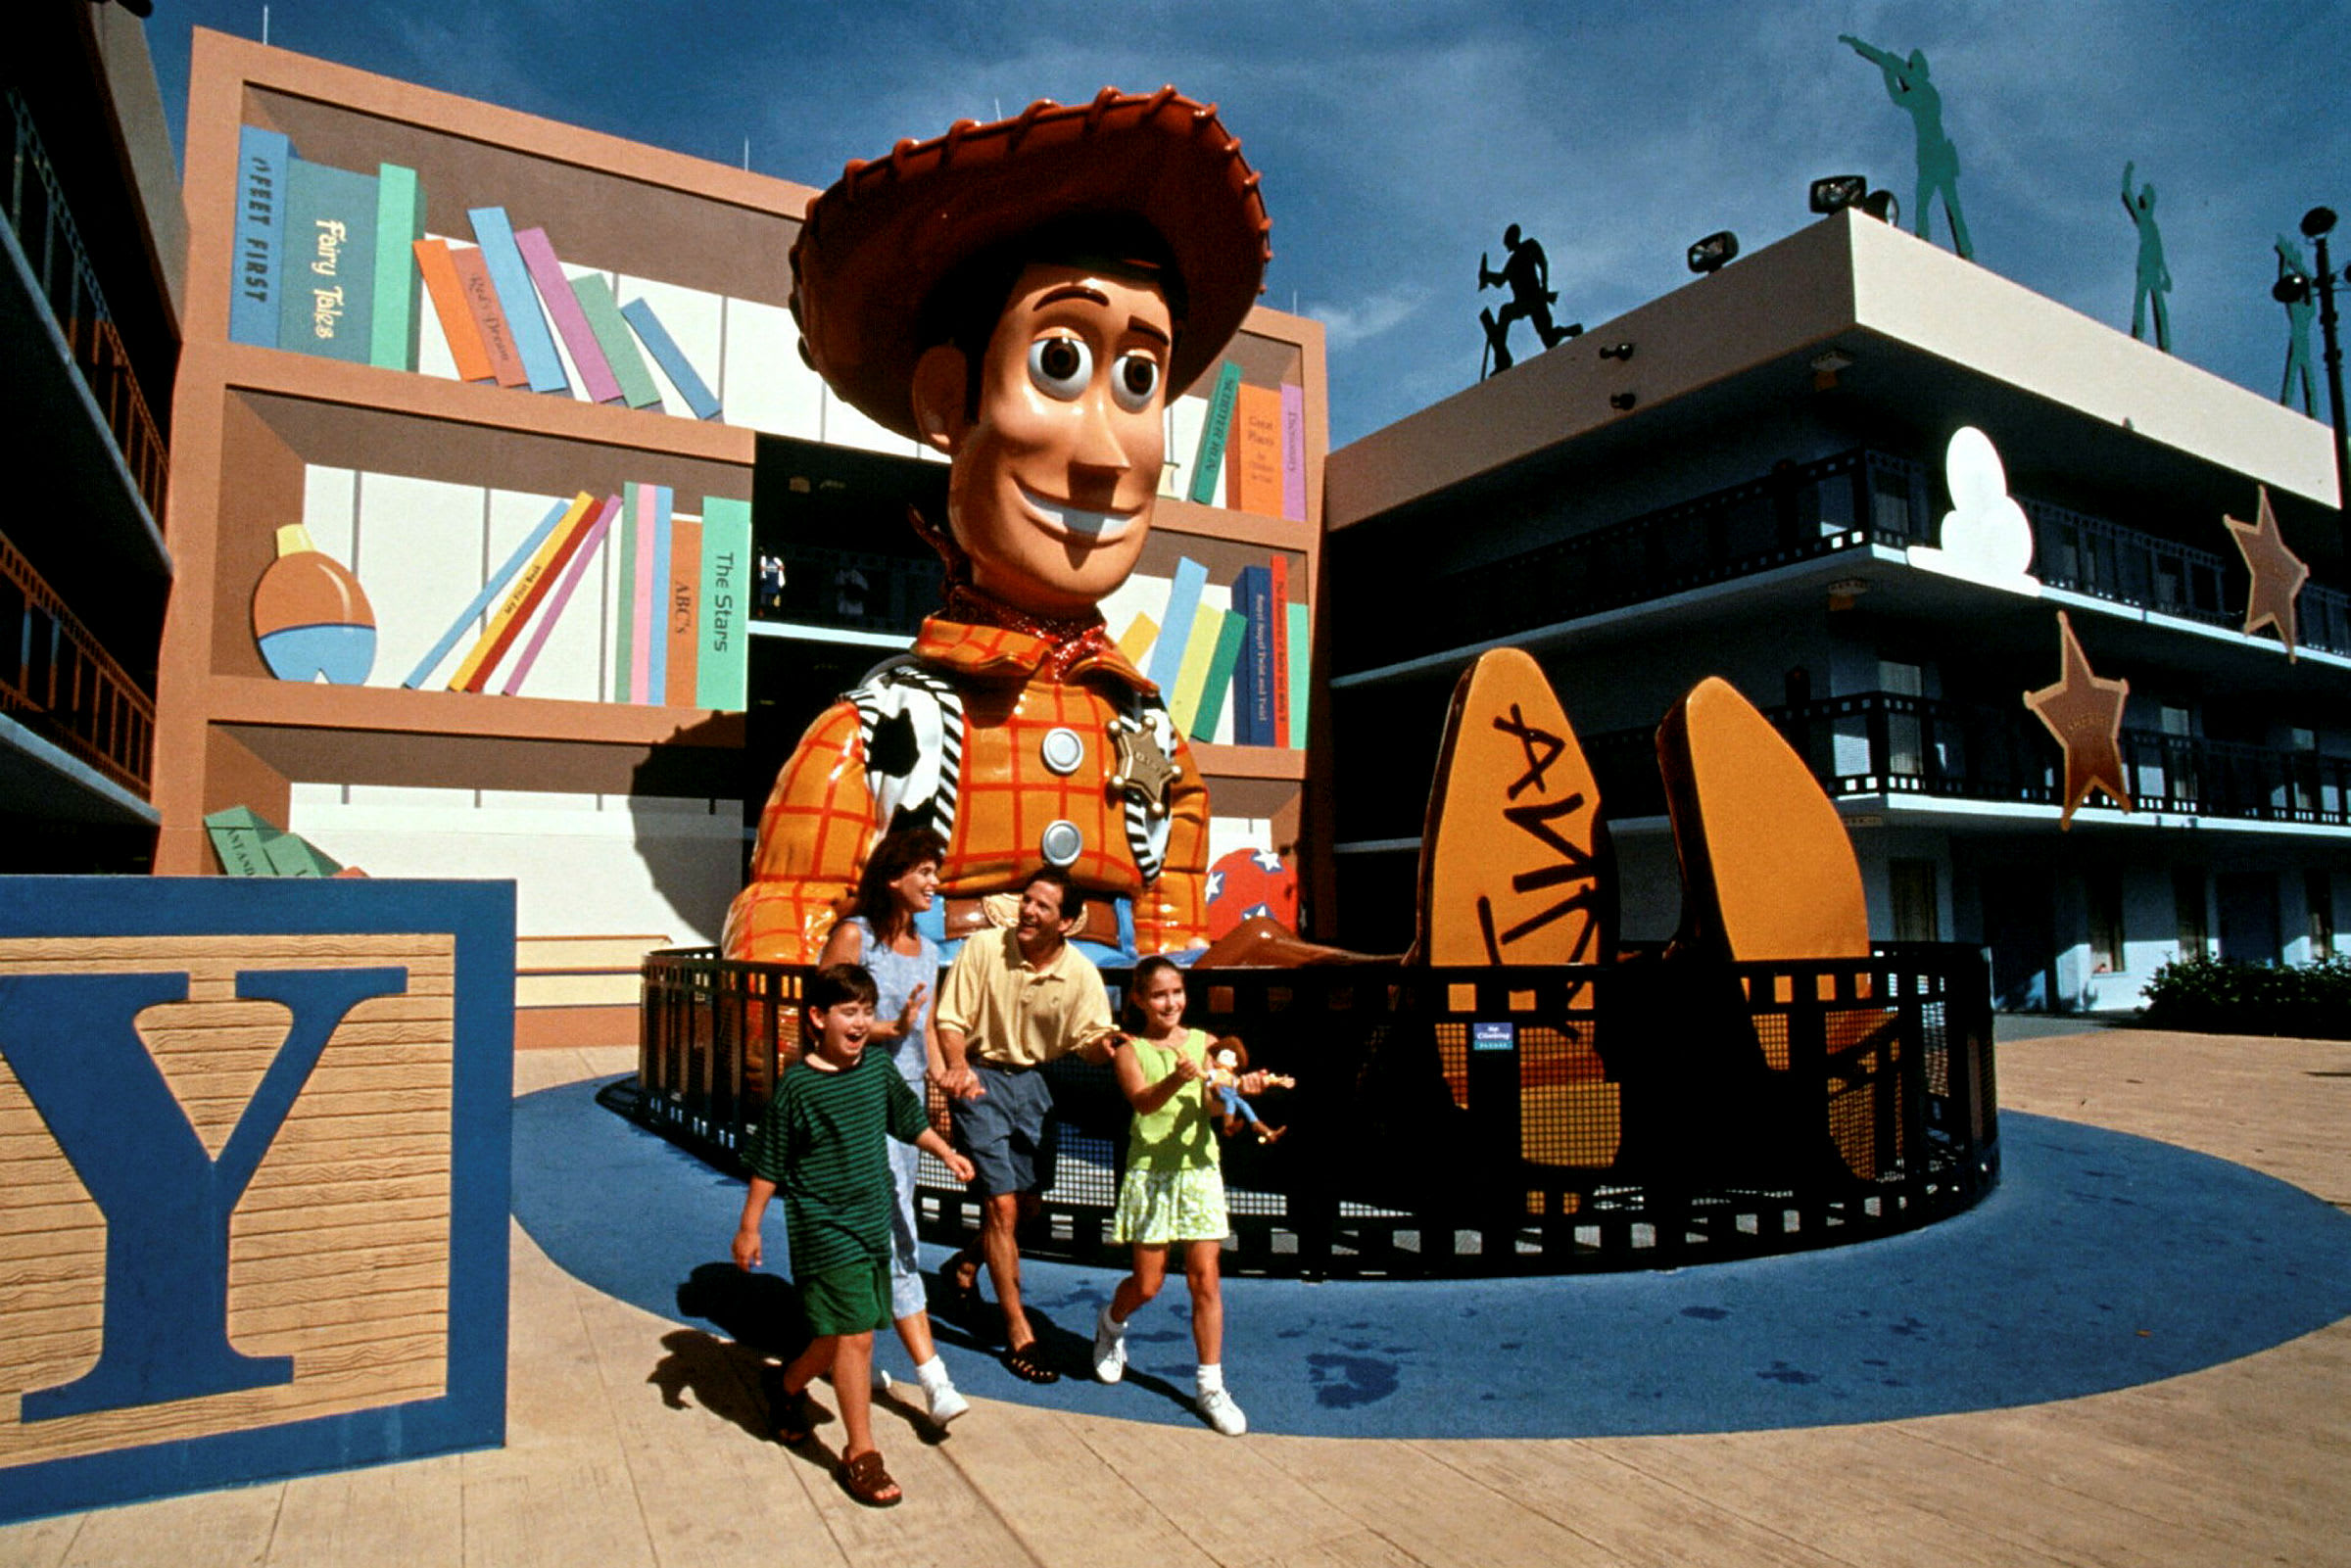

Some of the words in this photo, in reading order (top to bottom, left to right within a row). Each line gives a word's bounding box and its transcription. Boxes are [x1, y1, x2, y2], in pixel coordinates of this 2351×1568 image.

[248, 174, 272, 226] FEET
[244, 237, 268, 303] FIRST
[312, 220, 346, 276] Fairy
[314, 286, 343, 339] Tales
[715, 552, 734, 587] The
[675, 582, 692, 634] ABC's
[714, 594, 733, 652] Stars
[0, 965, 408, 1425] Y
